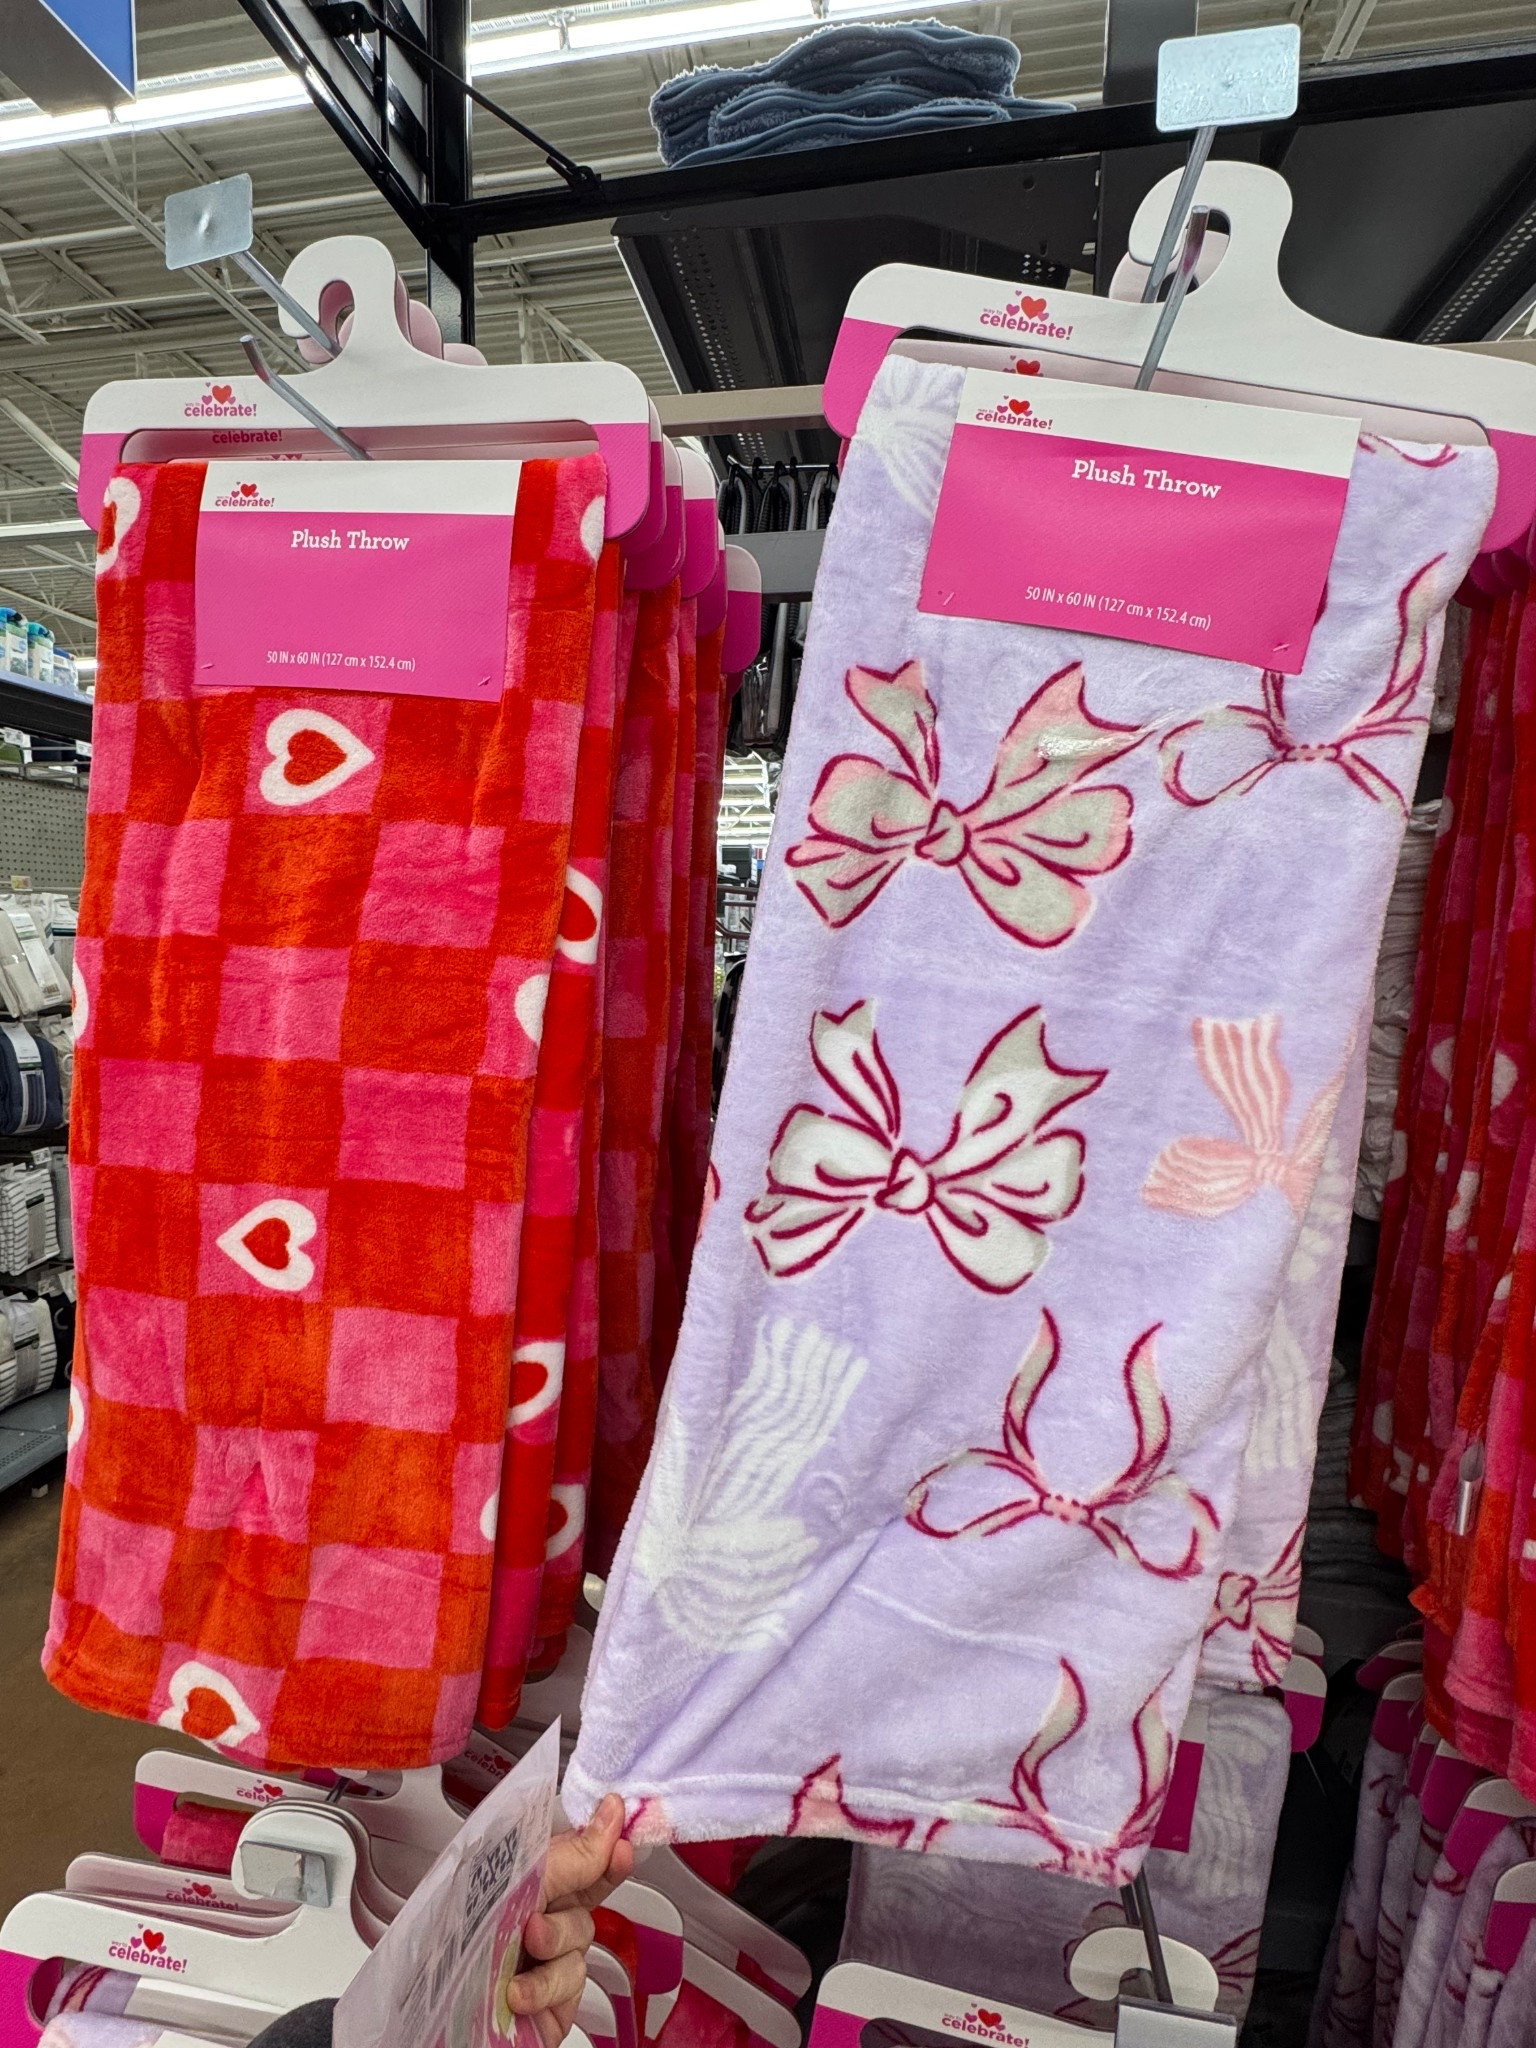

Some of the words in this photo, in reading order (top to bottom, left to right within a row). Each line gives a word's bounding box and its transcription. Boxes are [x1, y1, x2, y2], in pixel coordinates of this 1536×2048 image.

[980, 313, 1073, 341] celebrate!
[184, 403, 257, 417] celebrate!
[975, 411, 1053, 430] celebrate!
[212, 430, 283, 444] celebrate!
[1071, 459, 1136, 487] Plush
[1143, 469, 1222, 499] Throw
[215, 497, 275, 507] celebrate!
[291, 529, 342, 549] Plush
[347, 529, 410, 551] Throw
[1025, 586, 1040, 600] 50
[1042, 588, 1056, 603] IN
[1056, 592, 1064, 604] x
[1066, 591, 1082, 606] 60
[1083, 594, 1097, 609] IN
[1098, 596, 1125, 612] (127
[1126, 603, 1143, 617] cm
[1145, 607, 1153, 618] x
[1156, 606, 1187, 625] 152.4
[1189, 614, 1211, 632] cm)
[266, 651, 278, 664] 50
[279, 651, 289, 664] IN
[290, 653, 296, 664] x
[297, 652, 308, 665] 60
[310, 652, 320, 665] IN
[321, 652, 343, 667] (127
[344, 656, 359, 667] cm
[360, 657, 367, 668] x
[369, 655, 395, 669] 152.4
[397, 658, 416, 673] cm)
[165, 1891, 240, 1911] celebrate!
[108, 1945, 188, 1974] celebrate!
[941, 2017, 1030, 2048] celebrate!
